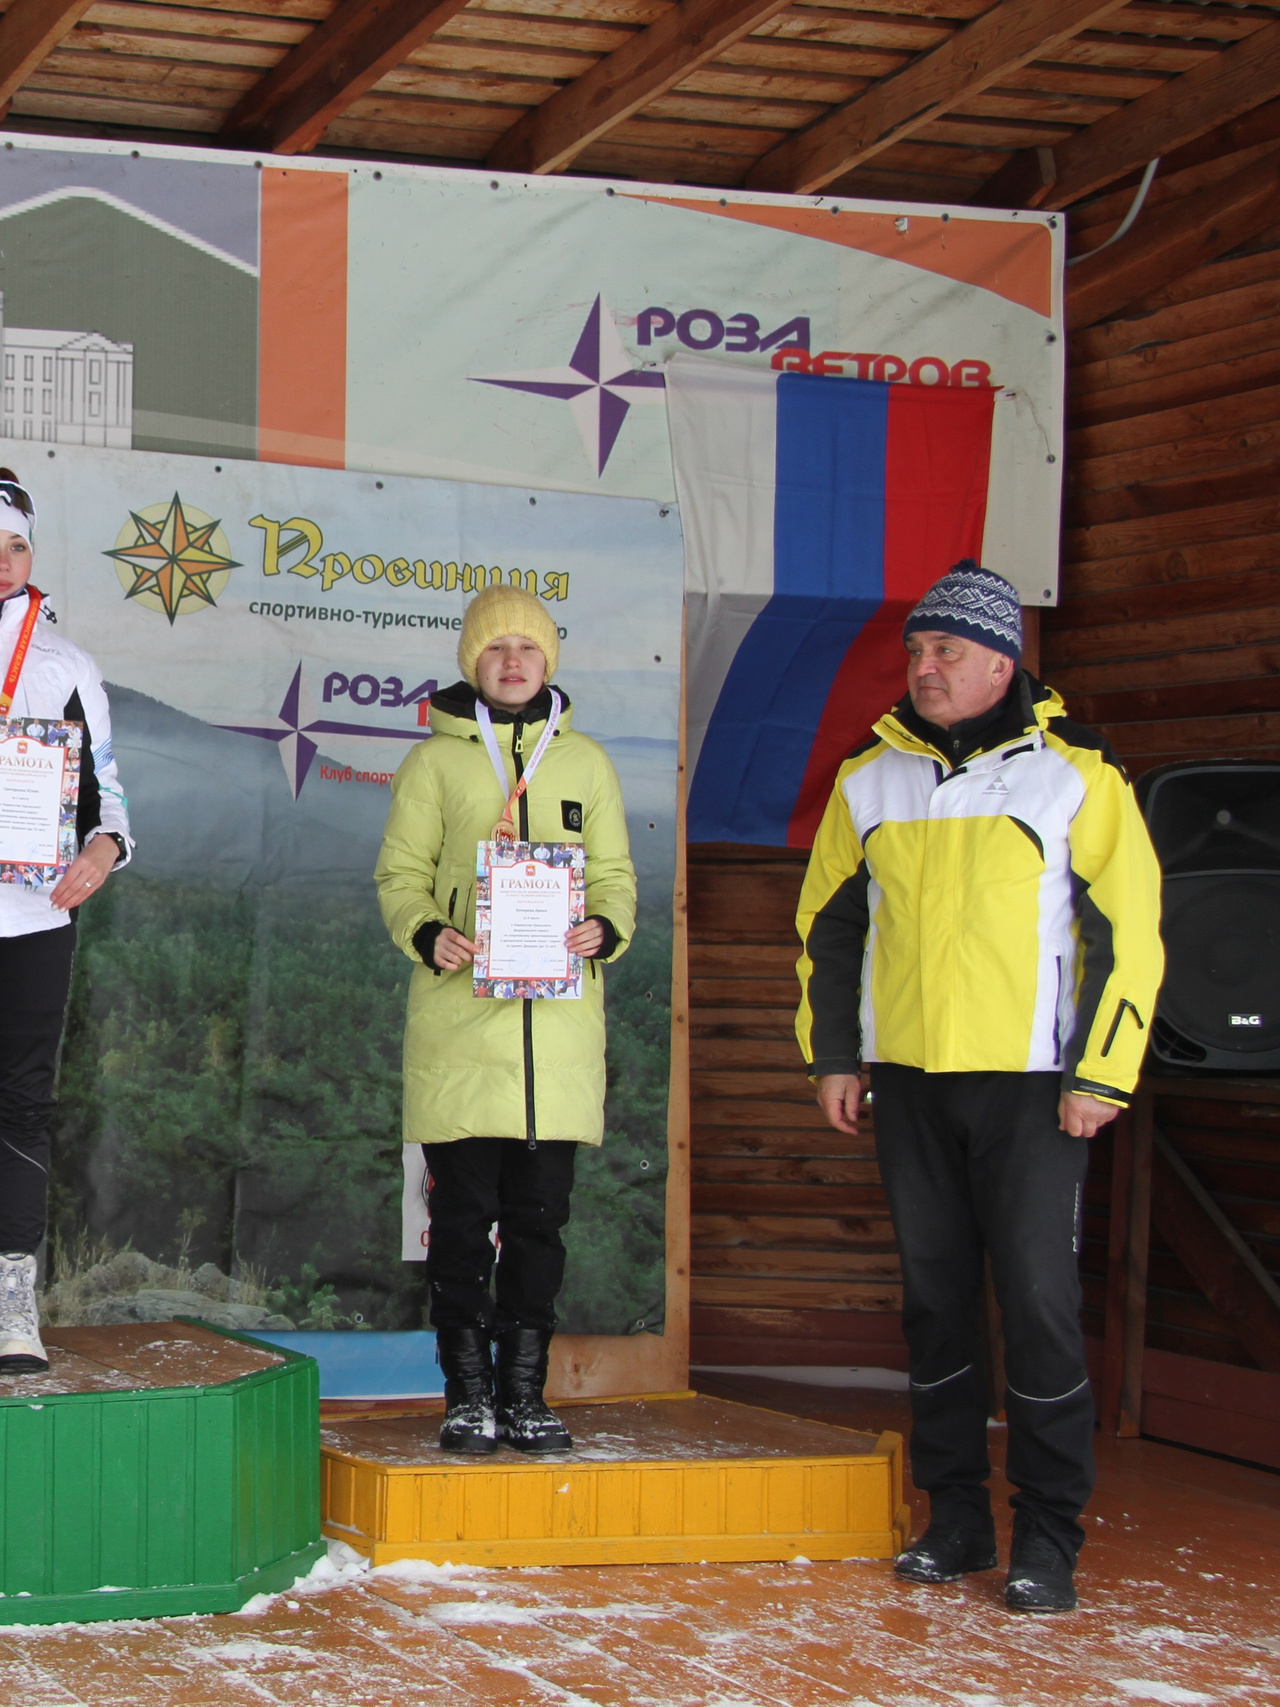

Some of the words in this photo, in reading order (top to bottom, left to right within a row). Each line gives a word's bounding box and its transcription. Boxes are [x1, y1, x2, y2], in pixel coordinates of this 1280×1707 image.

[637, 307, 810, 352] РОЗА
[249, 601, 462, 631] спортивно-туристиче
[323, 671, 438, 708] РОЗА
[320, 766, 352, 784] Клуб
[356, 770, 396, 787] спорт
[500, 878, 561, 889] ГРАМОТА
[1231, 1015, 1260, 1025] B&G
